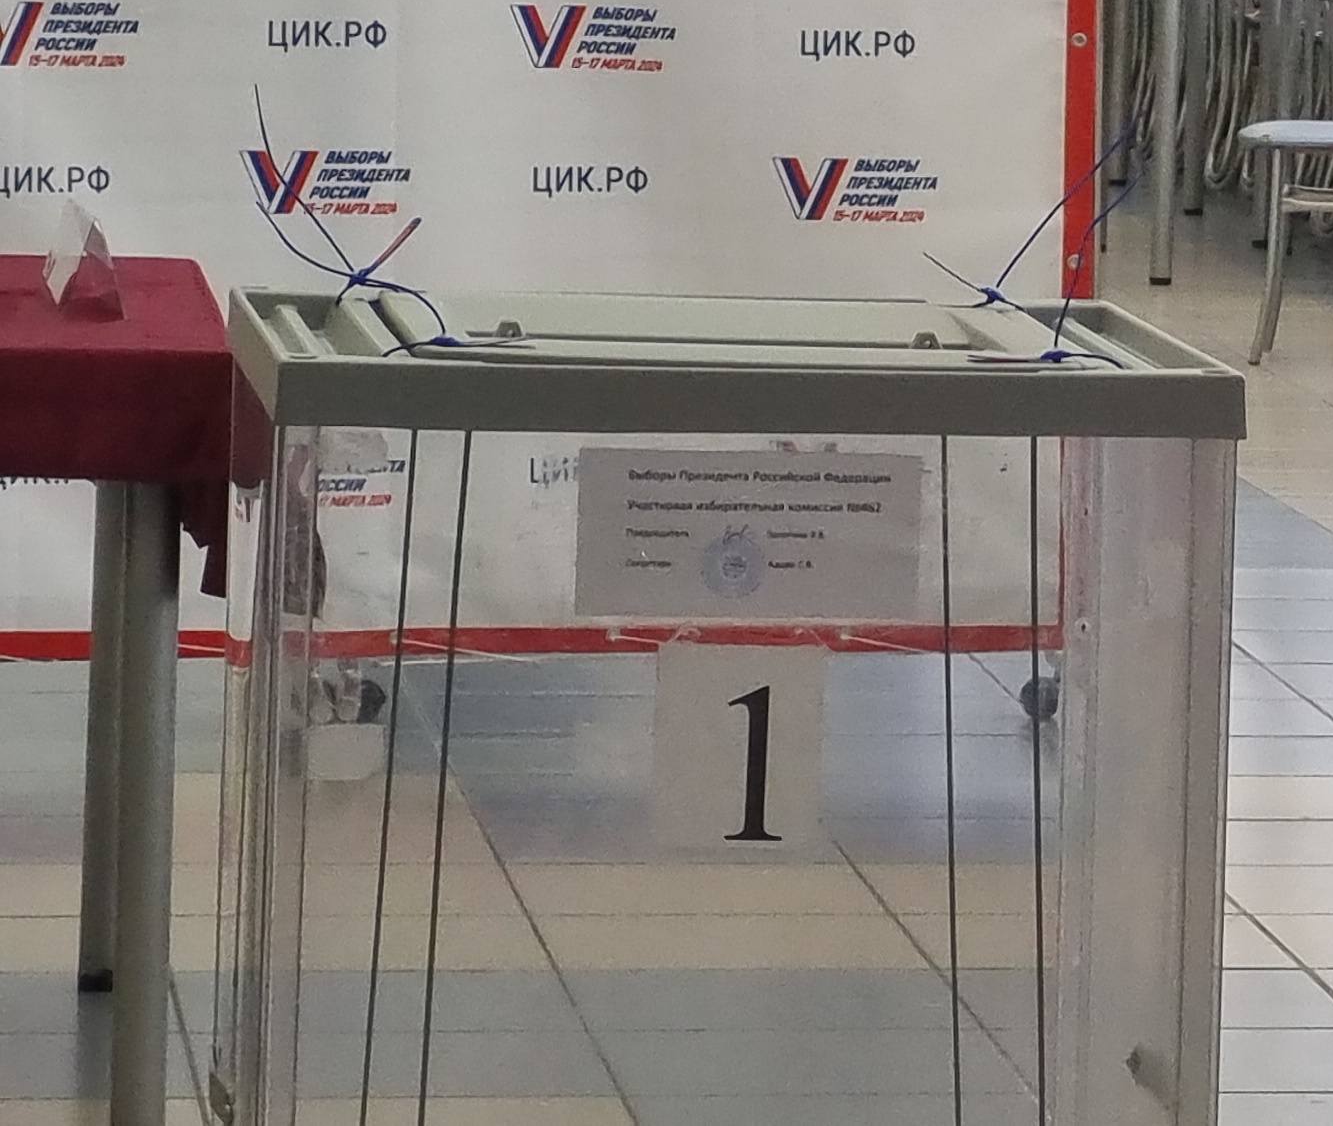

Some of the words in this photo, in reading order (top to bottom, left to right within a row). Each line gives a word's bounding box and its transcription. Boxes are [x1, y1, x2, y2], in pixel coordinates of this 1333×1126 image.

[50, 3, 120, 15] ВЫБОРЫ
[593, 7, 658, 22] ВЫБОРЫ
[43, 20, 139, 35] ПРЕЗИДЕНТА
[584, 24, 676, 40] ПРЕЗИДЕНТА
[268, 20, 387, 53] ЦИК.РФ
[35, 38, 97, 51] РОССИИ
[577, 41, 637, 55] РОССИИ
[800, 29, 916, 62] ЦИК.РФ
[61, 55, 97, 66] МАРТА
[600, 58, 636, 70] МАРТА
[325, 151, 392, 164] ВЫБОРЫ
[854, 159, 920, 172] ВЫБОРЫ
[317, 169, 411, 182] ПРЕЗИДЕНТА
[532, 165, 648, 198] ЦИК.РФ
[846, 177, 938, 190] ПРЕЗИДЕНТА
[309, 186, 370, 199] РОССИИ
[839, 194, 898, 207] РОССИИ
[334, 203, 370, 214] МАРТА
[863, 211, 898, 221] МАРТА
[629, 470, 676, 482] Выборы
[679, 470, 750, 482] Президента
[753, 471, 821, 482] Российской
[824, 472, 891, 483] Федерации
[723, 684, 782, 841] 1
